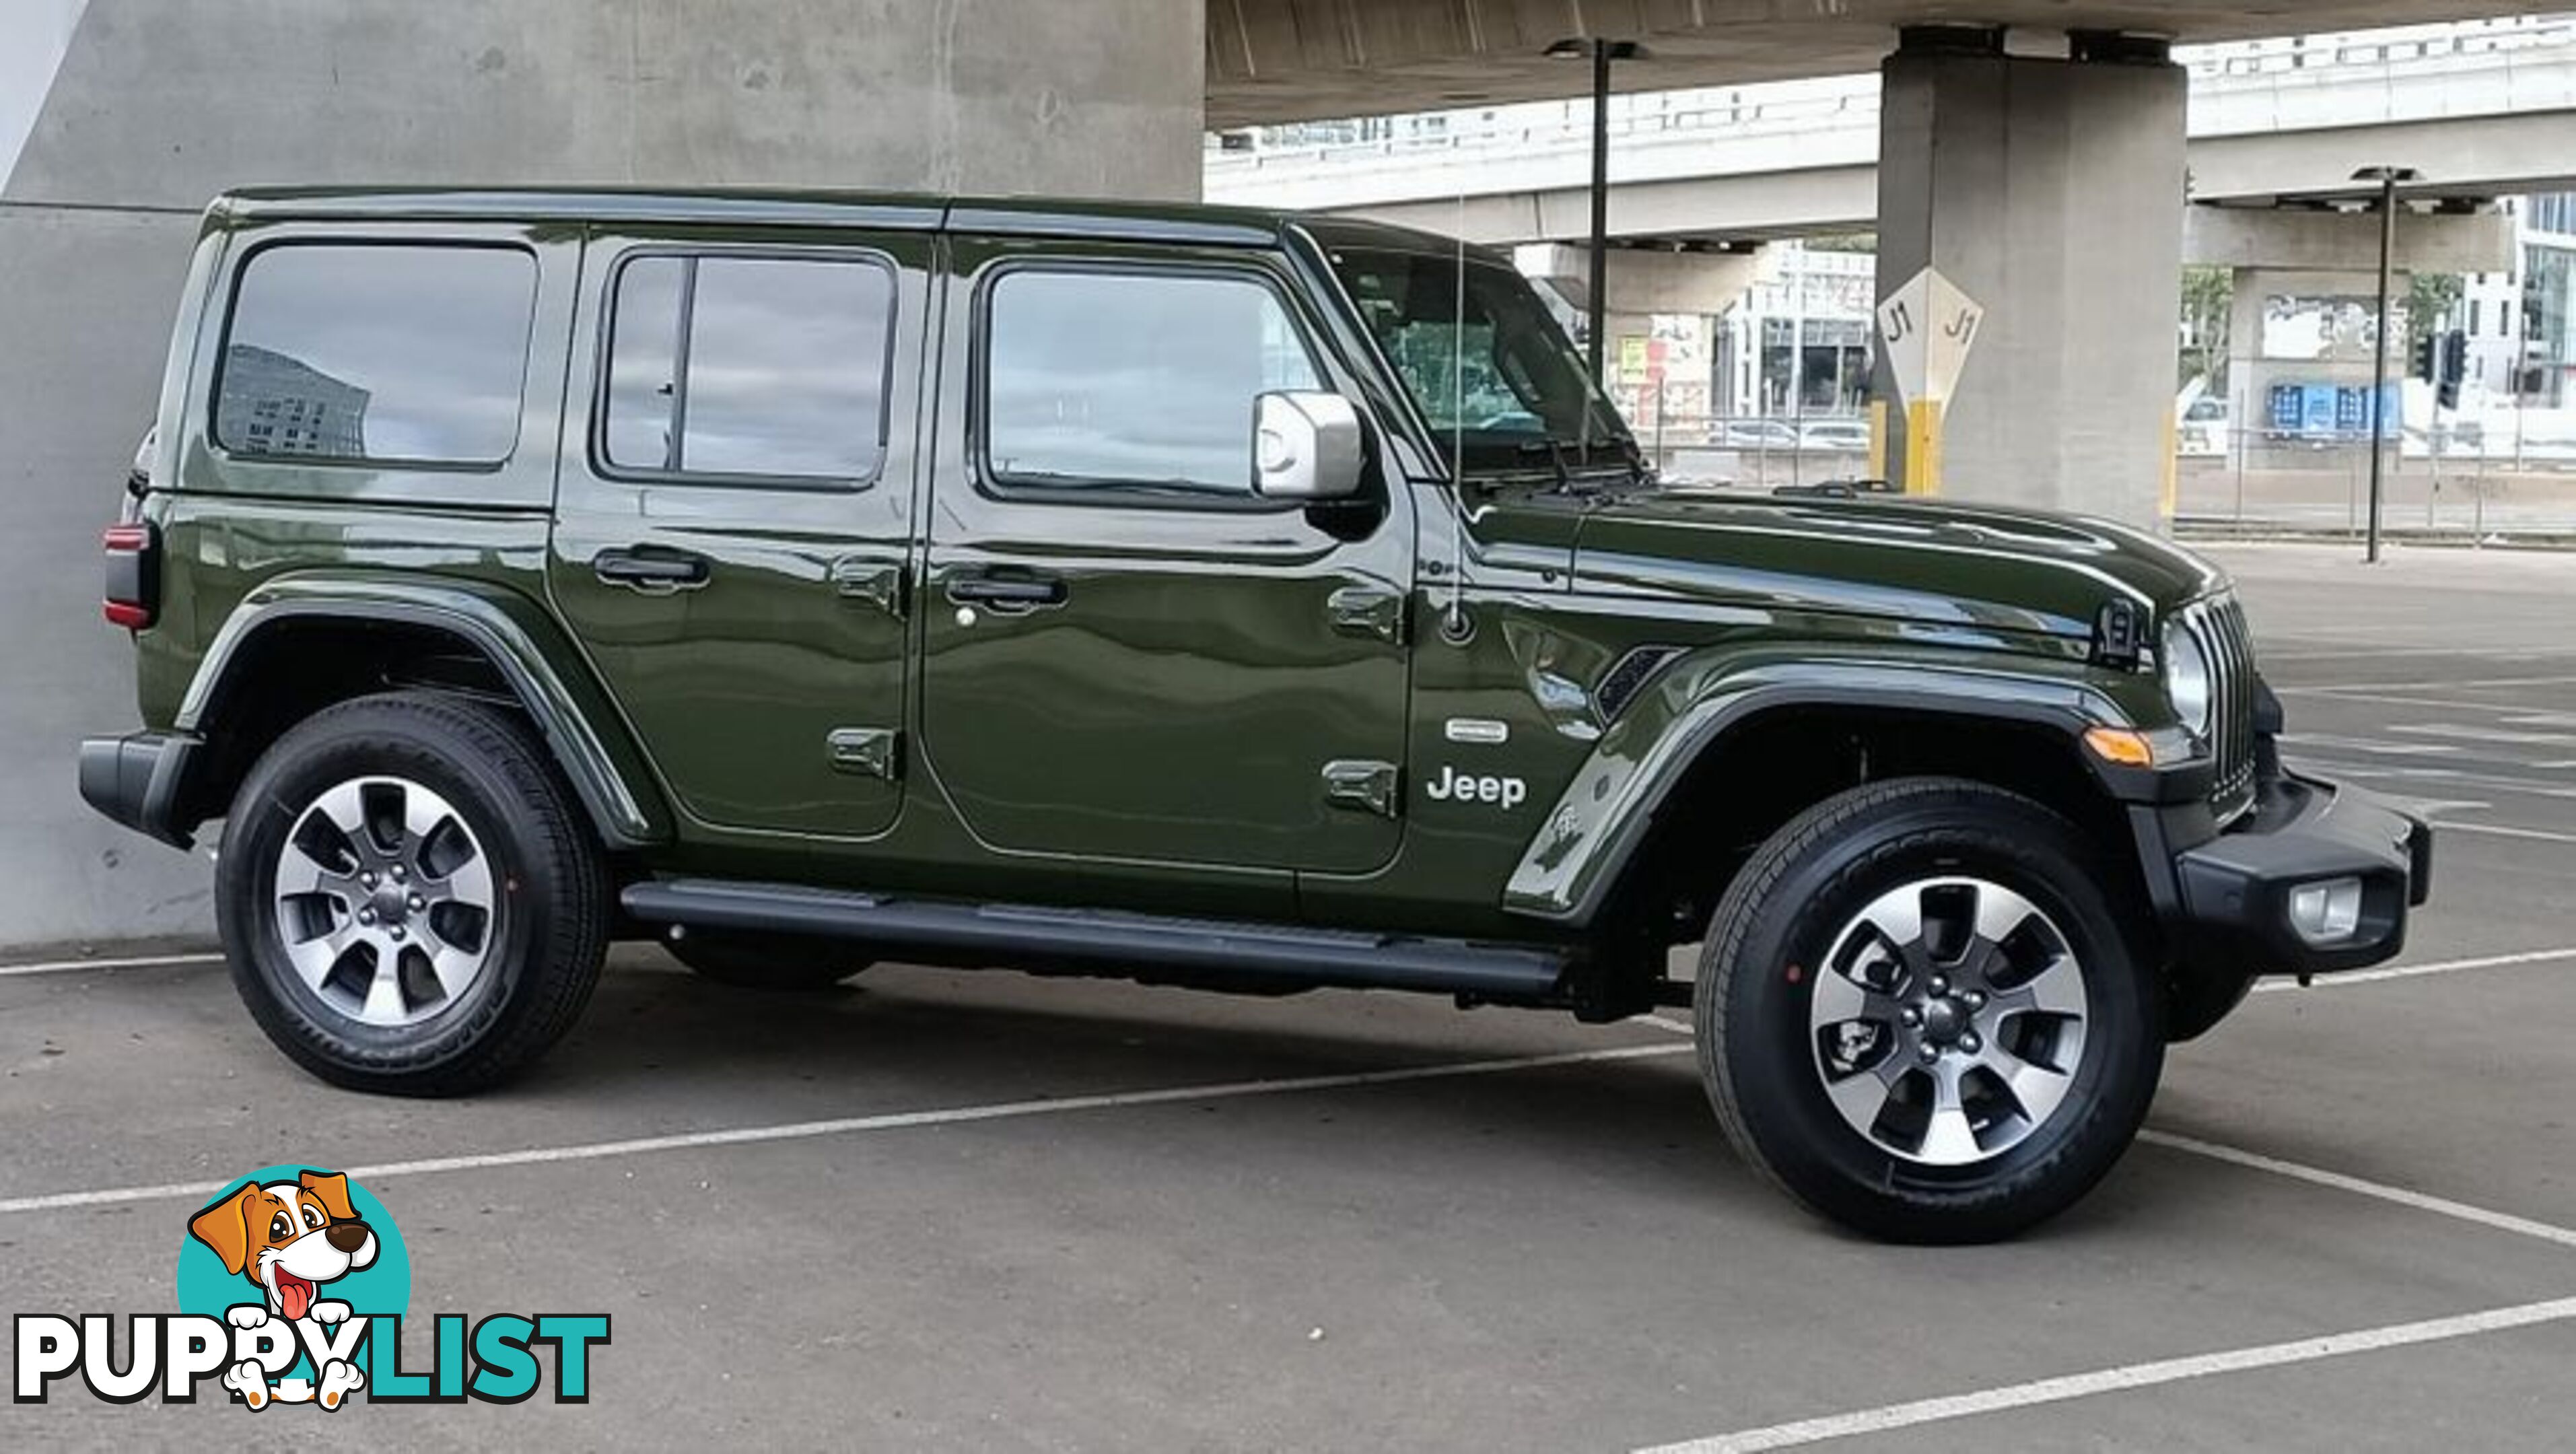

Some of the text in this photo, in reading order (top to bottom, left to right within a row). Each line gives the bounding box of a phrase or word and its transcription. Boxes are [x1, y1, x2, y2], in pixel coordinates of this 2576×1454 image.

[1889, 301, 1912, 342] J1
[1945, 309, 1975, 344] J1
[1426, 765, 1526, 810] Jeep
